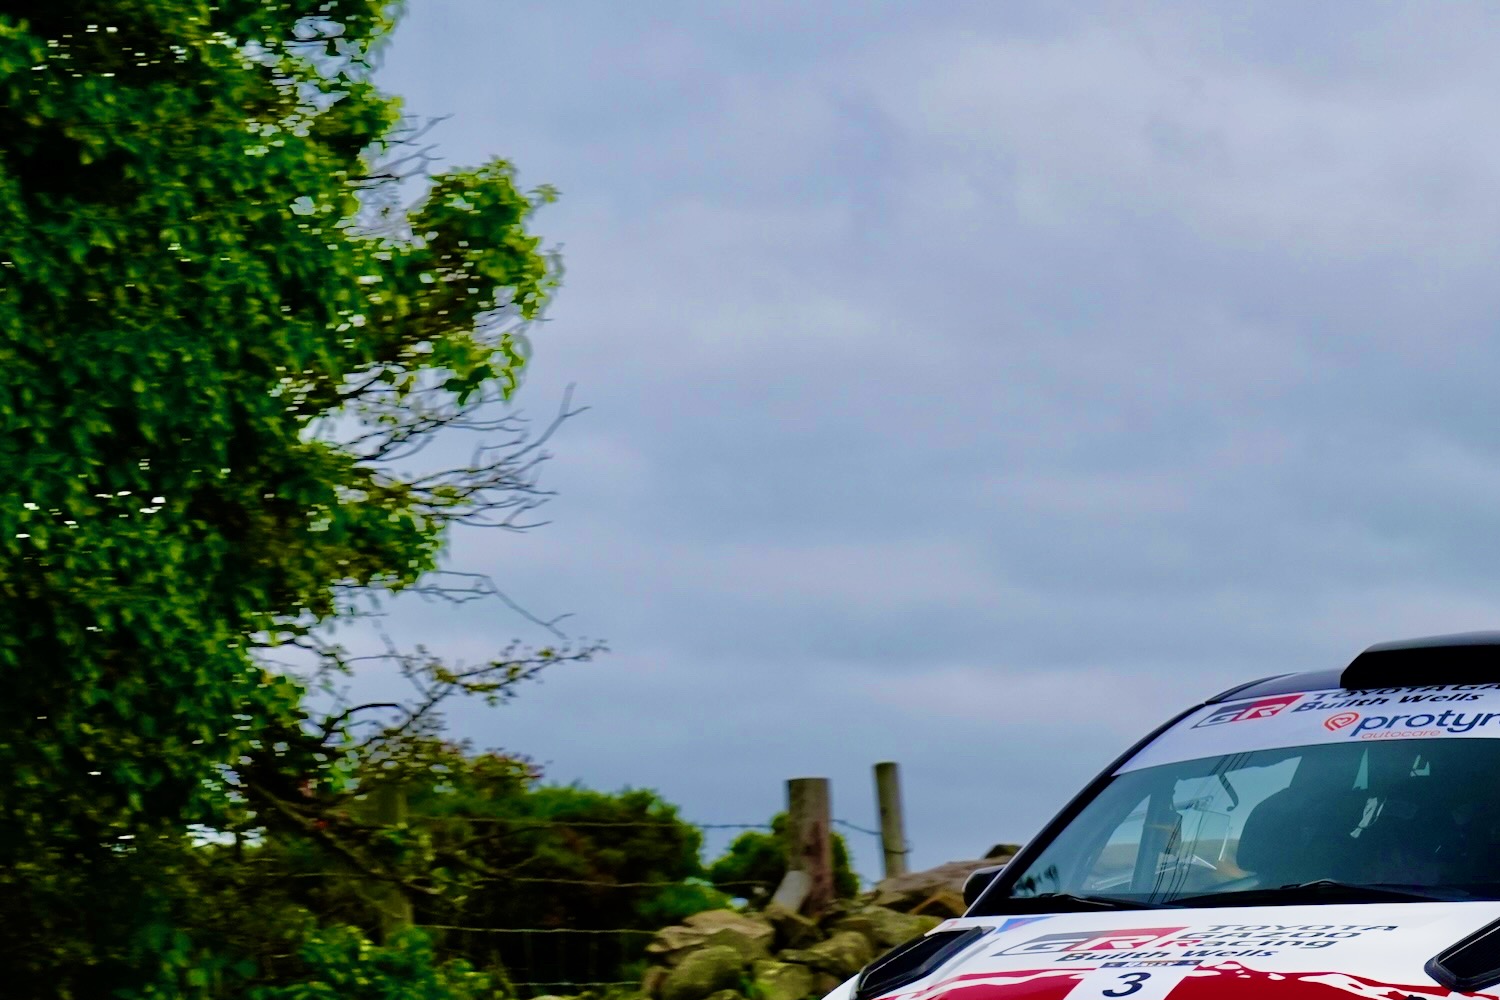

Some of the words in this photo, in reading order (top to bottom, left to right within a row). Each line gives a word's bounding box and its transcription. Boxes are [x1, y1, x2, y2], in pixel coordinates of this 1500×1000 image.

[1291, 698, 1390, 712] Builth
[1398, 693, 1484, 704] Wells
[1361, 729, 1441, 739] autocare
[1207, 924, 1399, 932] TOYOTA
[1177, 931, 1361, 939] GAZOO
[1155, 938, 1340, 949] Racing
[1054, 950, 1171, 962] Builth
[1181, 949, 1279, 958] Wells
[1102, 972, 1152, 998] 3
